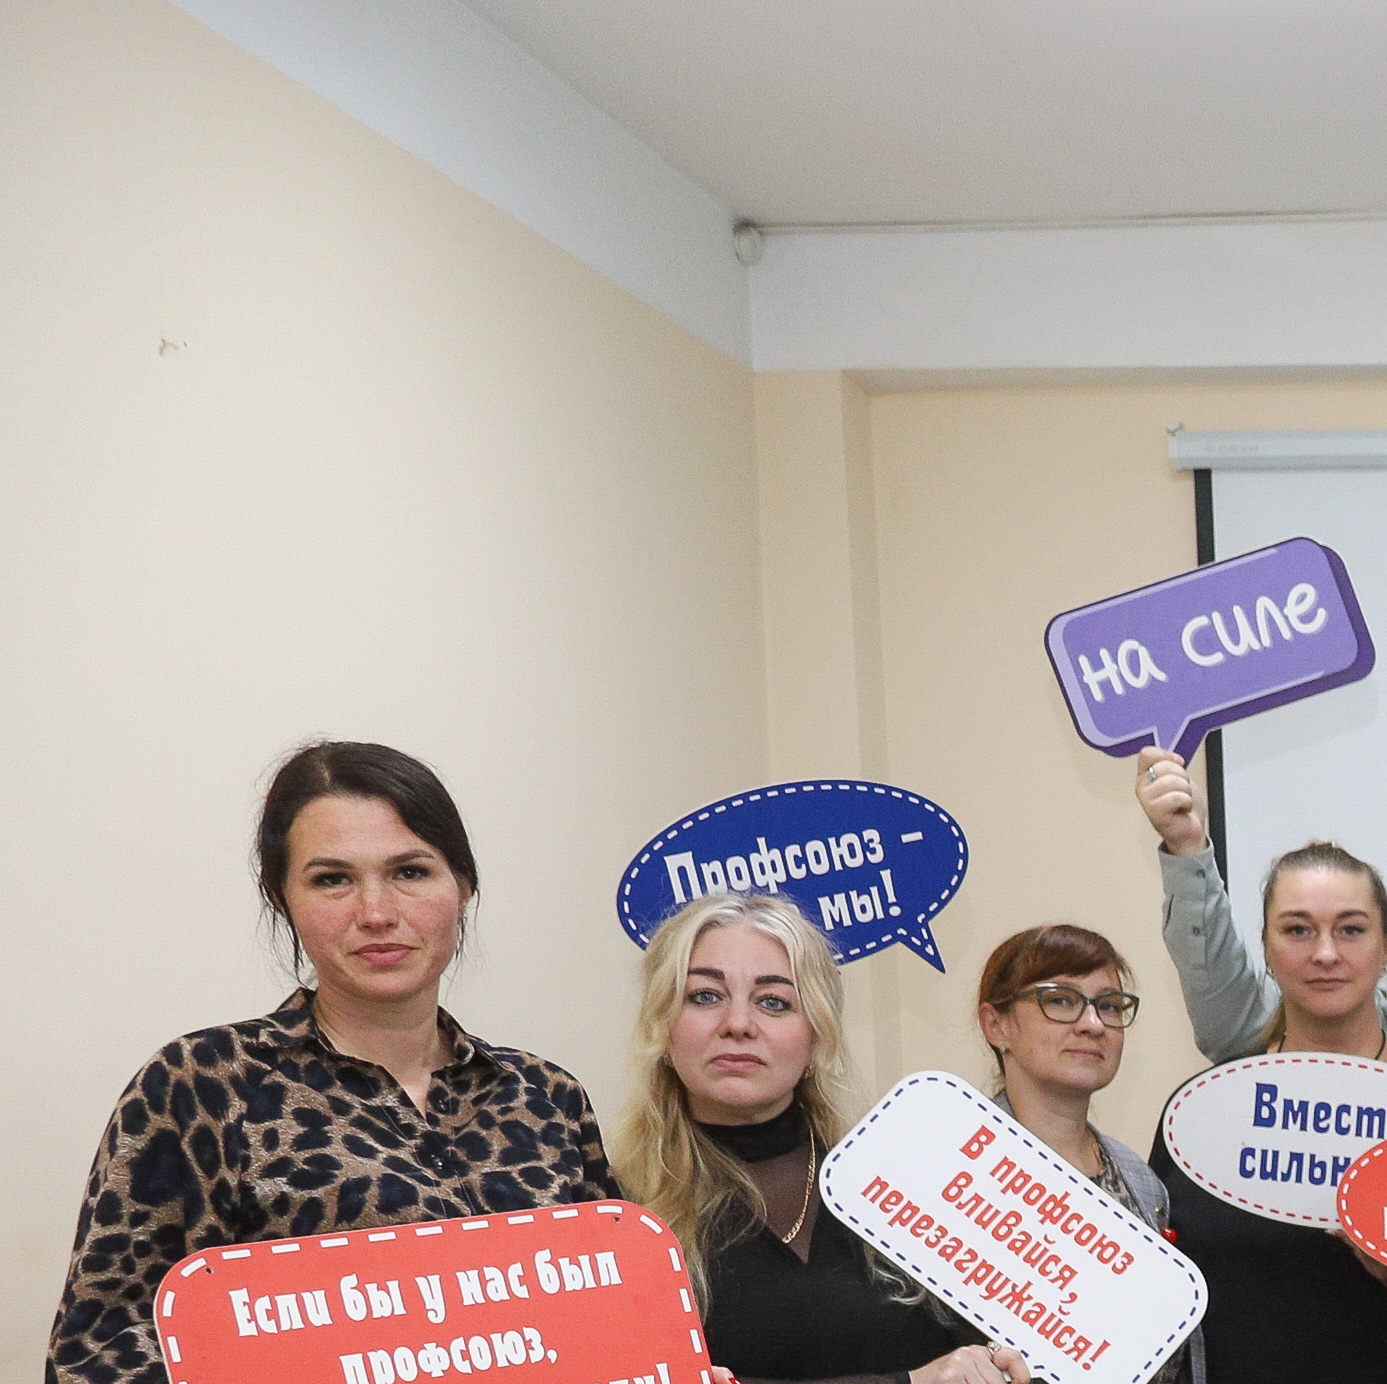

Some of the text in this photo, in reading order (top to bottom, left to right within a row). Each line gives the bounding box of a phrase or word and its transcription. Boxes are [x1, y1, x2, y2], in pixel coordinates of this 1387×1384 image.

[1079, 582, 1327, 702] на силе
[663, 828, 884, 904] Профсоюз
[817, 868, 901, 931] мы!
[959, 1124, 1135, 1276] В профсоюз
[1238, 1146, 1351, 1188] сильн
[860, 1175, 1112, 1371] перезагружайся!
[940, 1170, 1079, 1305] вливайся,
[228, 1247, 623, 1337] Если бы у нас был
